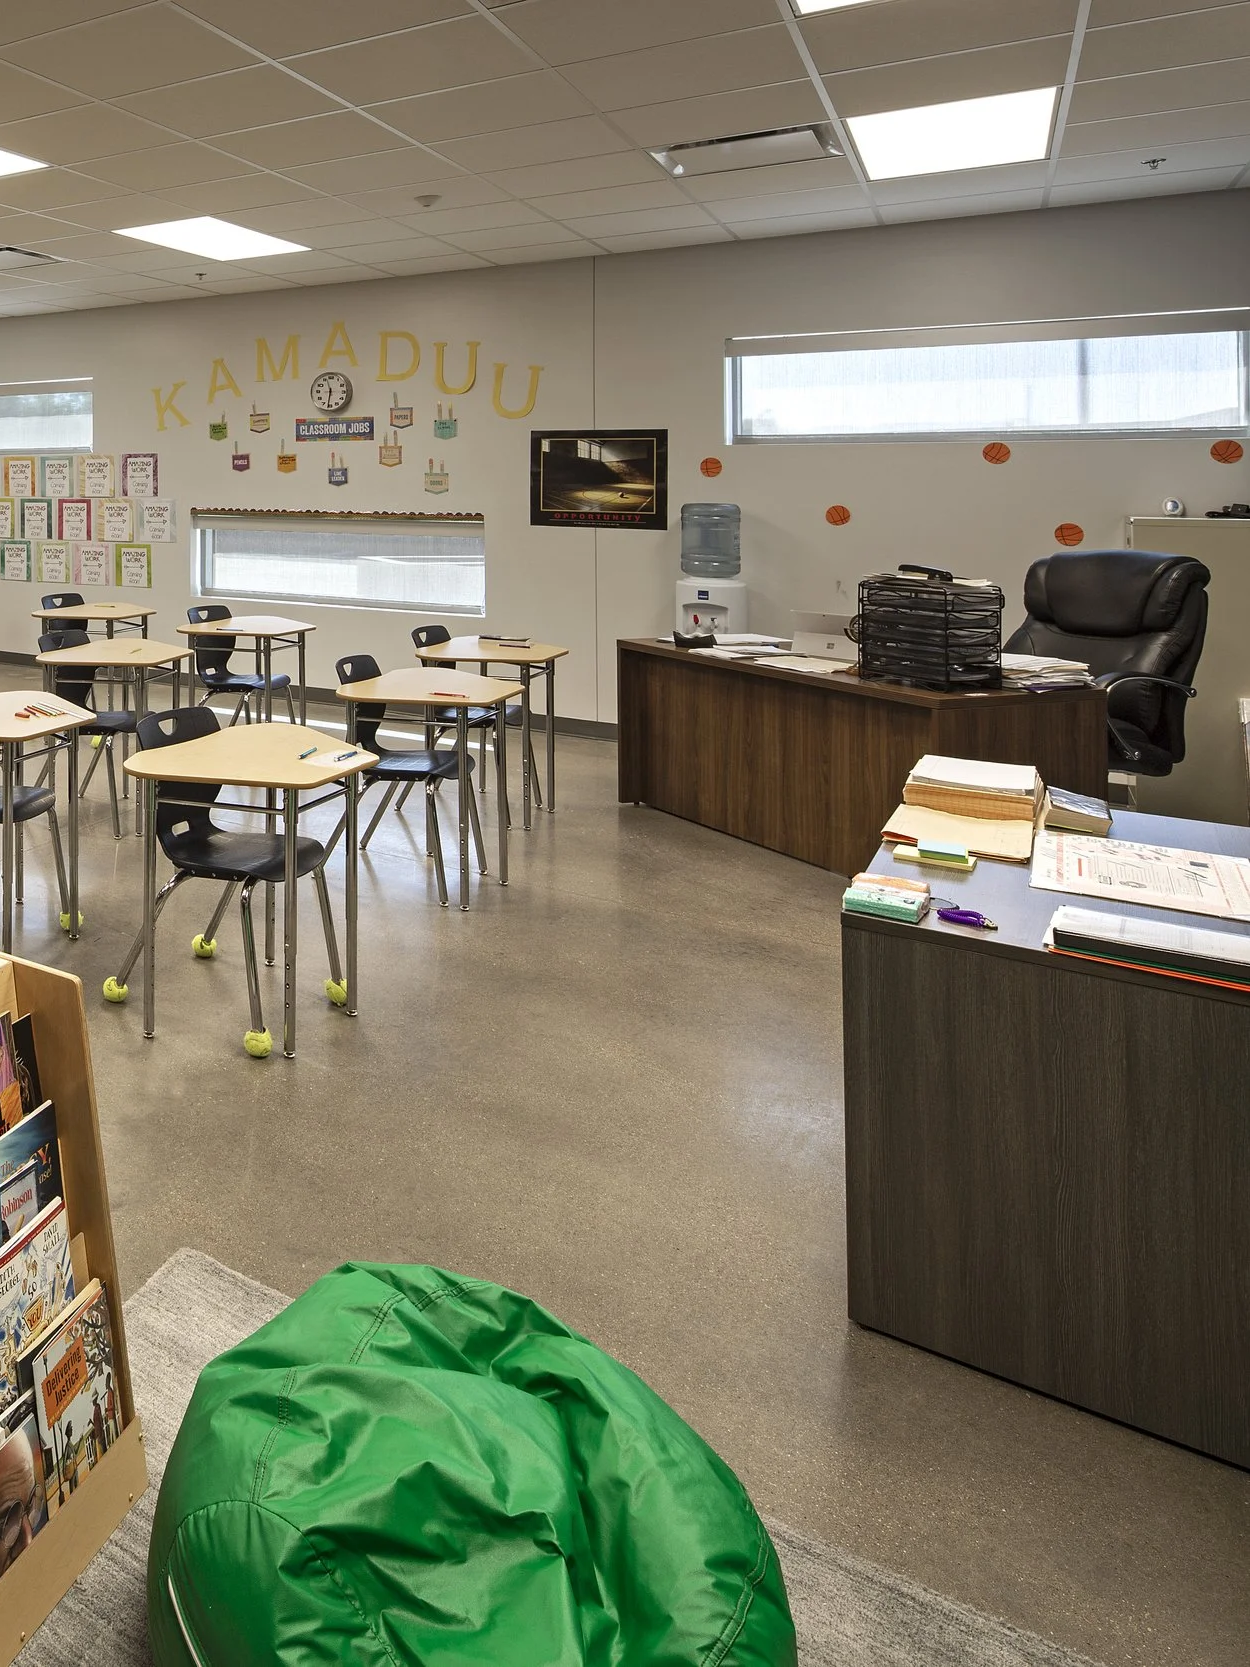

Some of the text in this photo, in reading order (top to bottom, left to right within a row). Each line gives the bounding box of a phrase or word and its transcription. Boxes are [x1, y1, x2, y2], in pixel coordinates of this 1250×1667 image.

[151, 320, 546, 432] KAMADUU
[299, 421, 370, 436] CLASSROOM JOBS
[554, 513, 641, 521] OPPORTUNITY
[27, 1281, 38, 1301] SO
[45, 1345, 82, 1397] Delivering
[55, 1368, 80, 1407] Justice
